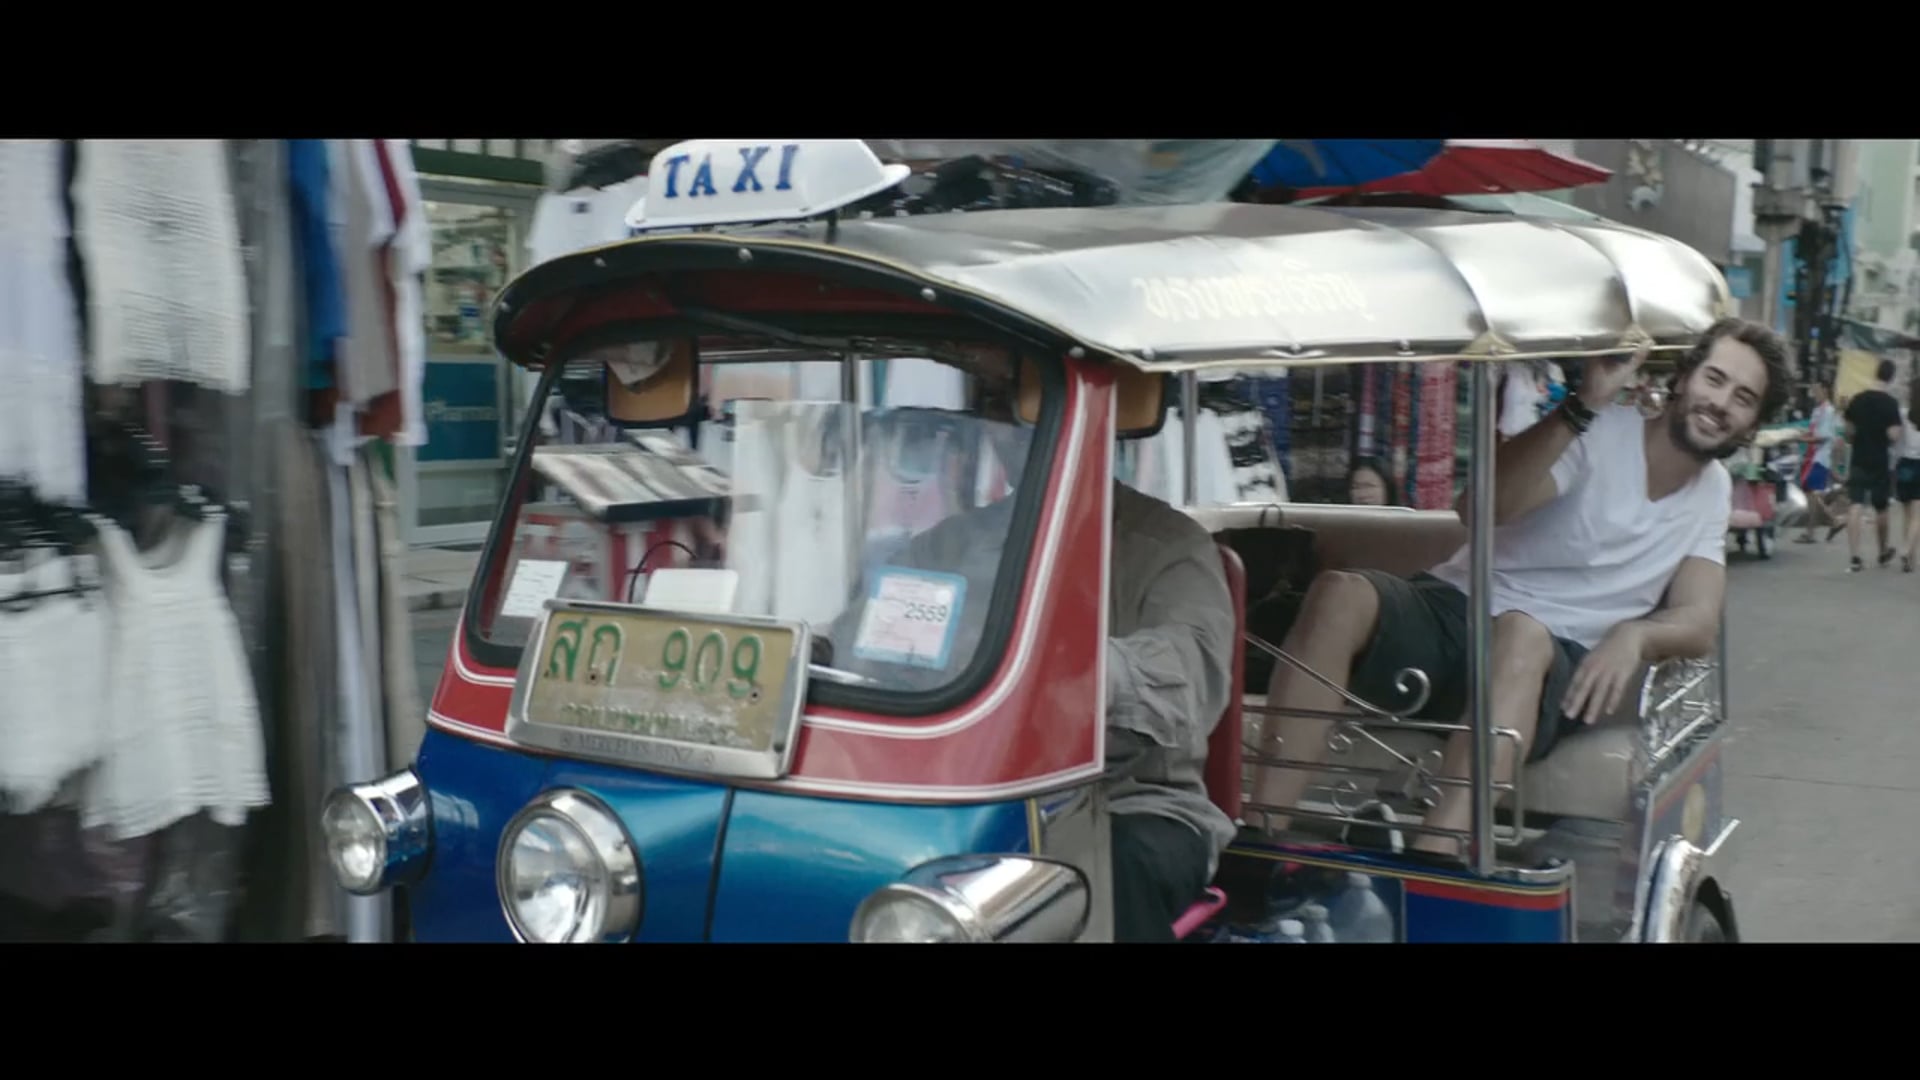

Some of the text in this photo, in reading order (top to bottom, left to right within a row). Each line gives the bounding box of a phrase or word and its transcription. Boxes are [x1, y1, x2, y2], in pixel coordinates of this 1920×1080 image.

[663, 144, 800, 198] TAXI
[903, 601, 948, 623] 2559
[658, 626, 764, 698] 909
